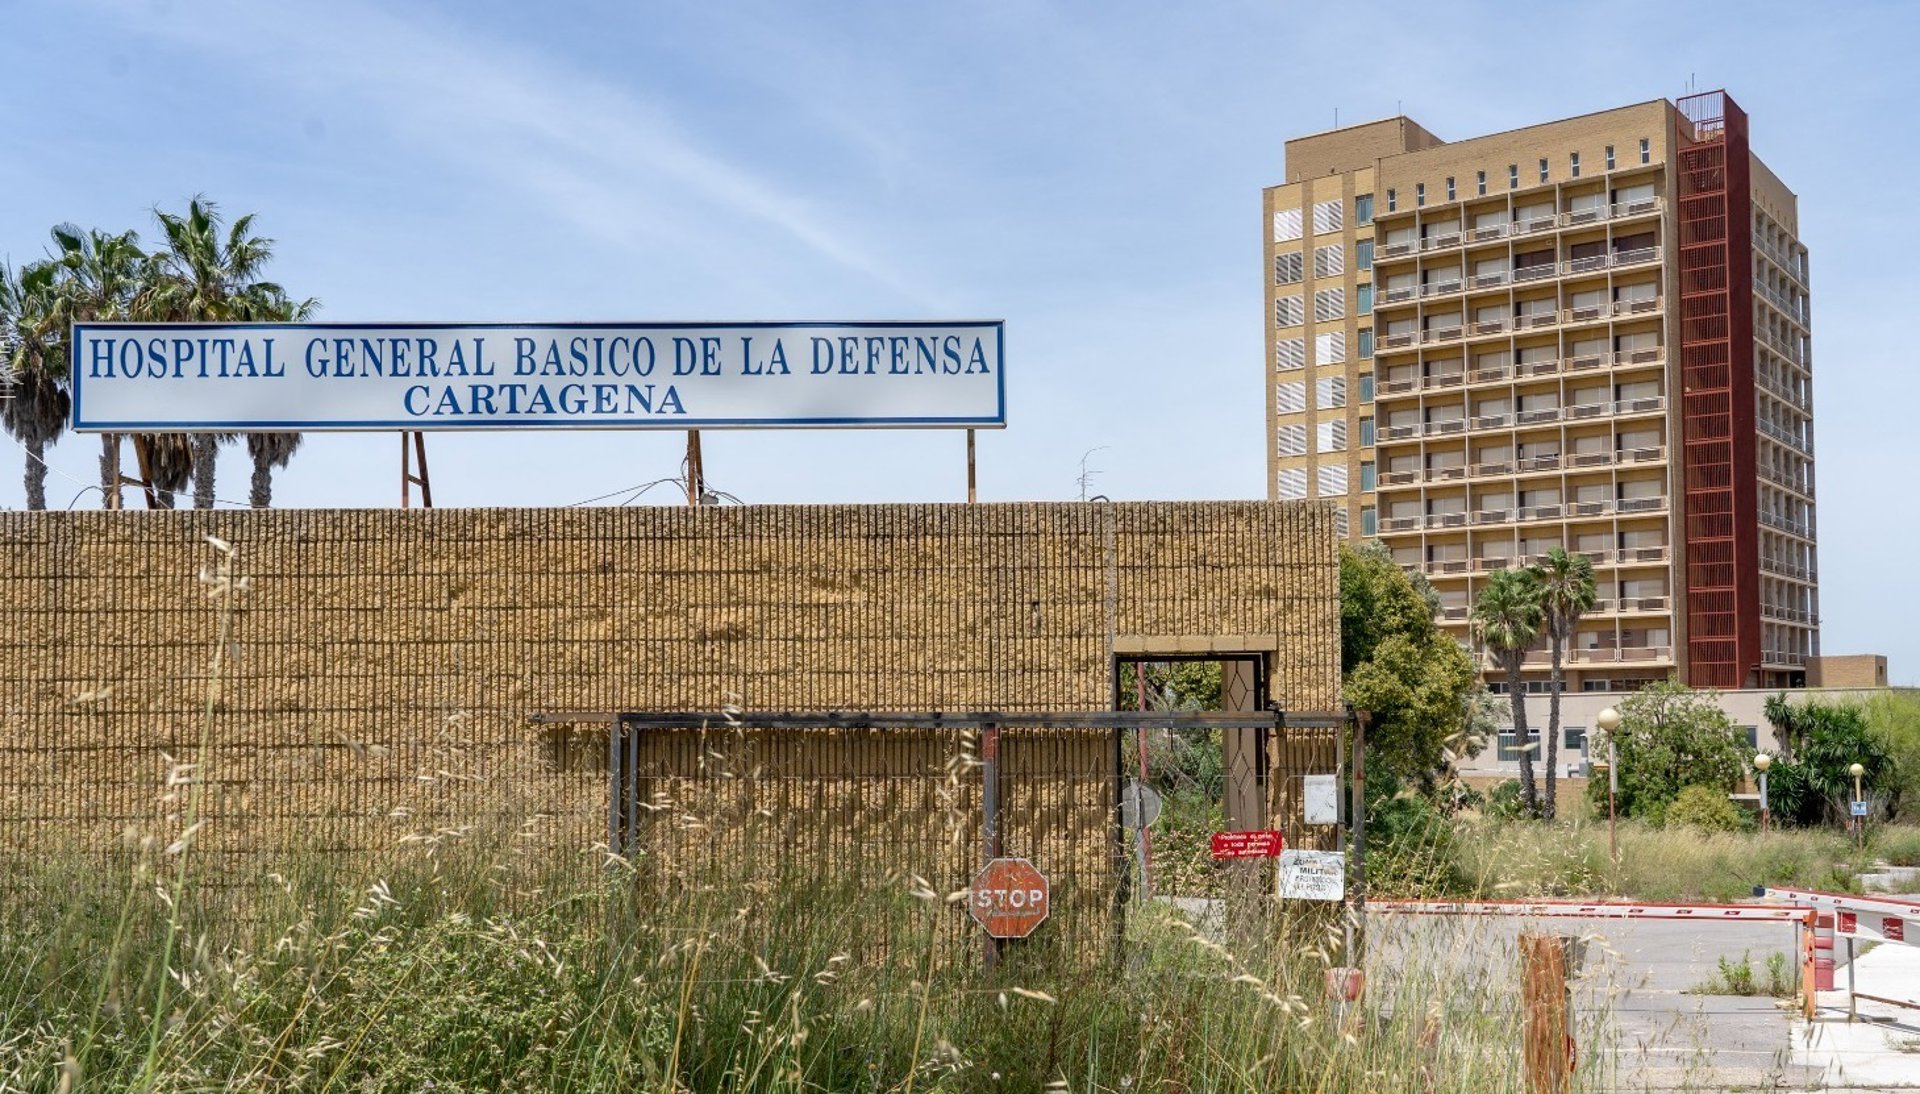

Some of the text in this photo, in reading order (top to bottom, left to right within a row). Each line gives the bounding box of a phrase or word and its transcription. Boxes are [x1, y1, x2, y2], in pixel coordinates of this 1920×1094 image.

[88, 335, 991, 379] HOSPITAL GENERAL BASICO DE LA DEFENSA
[403, 383, 688, 416] CARTAGENA
[977, 889, 1043, 908] STOP
